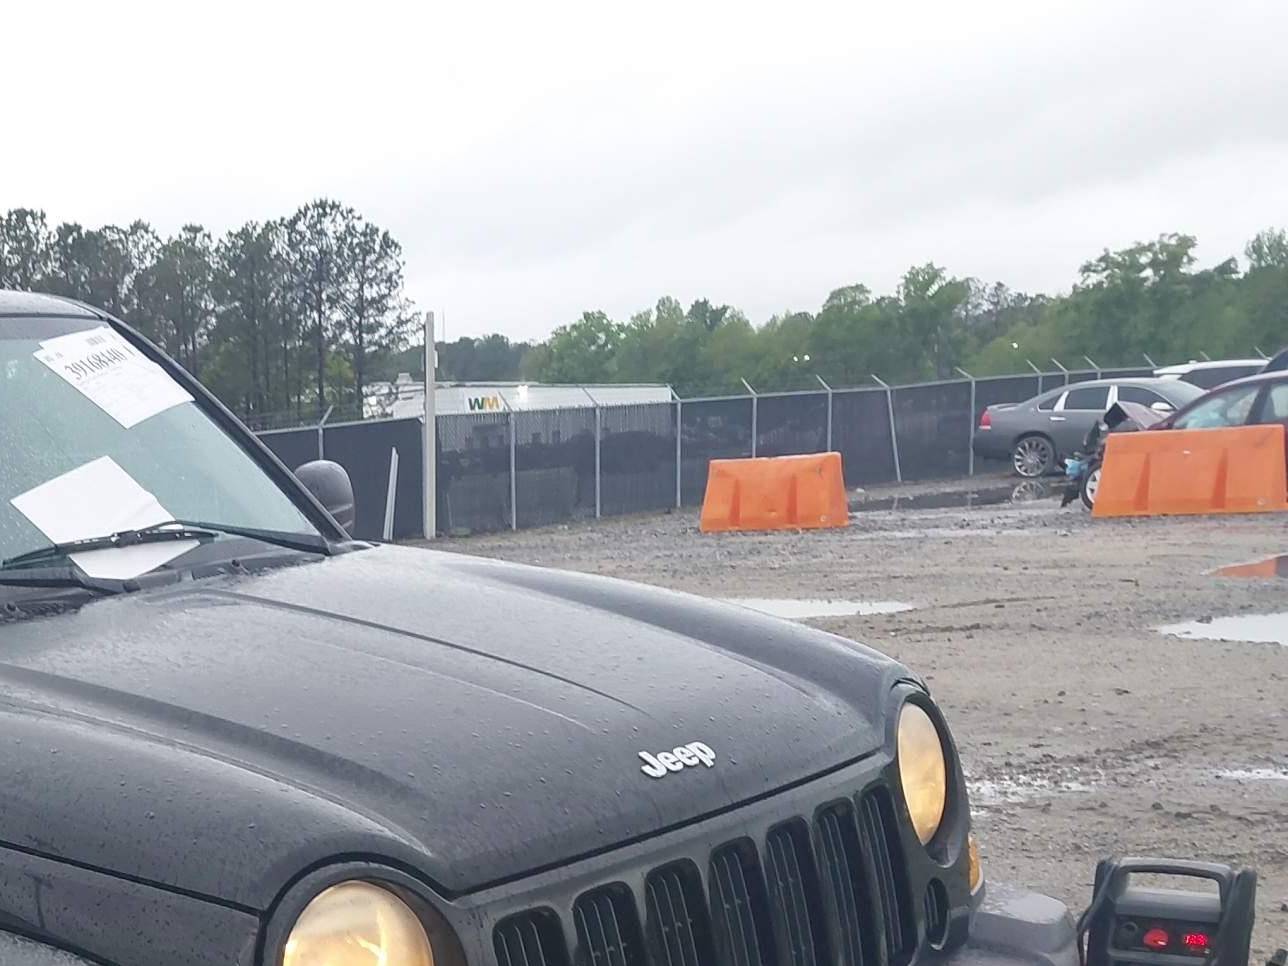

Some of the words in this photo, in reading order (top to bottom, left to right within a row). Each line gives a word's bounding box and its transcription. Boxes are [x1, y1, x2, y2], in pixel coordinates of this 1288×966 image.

[64, 347, 128, 380] 39168440
[468, 396, 500, 411] WM
[638, 741, 716, 778] Jeep
